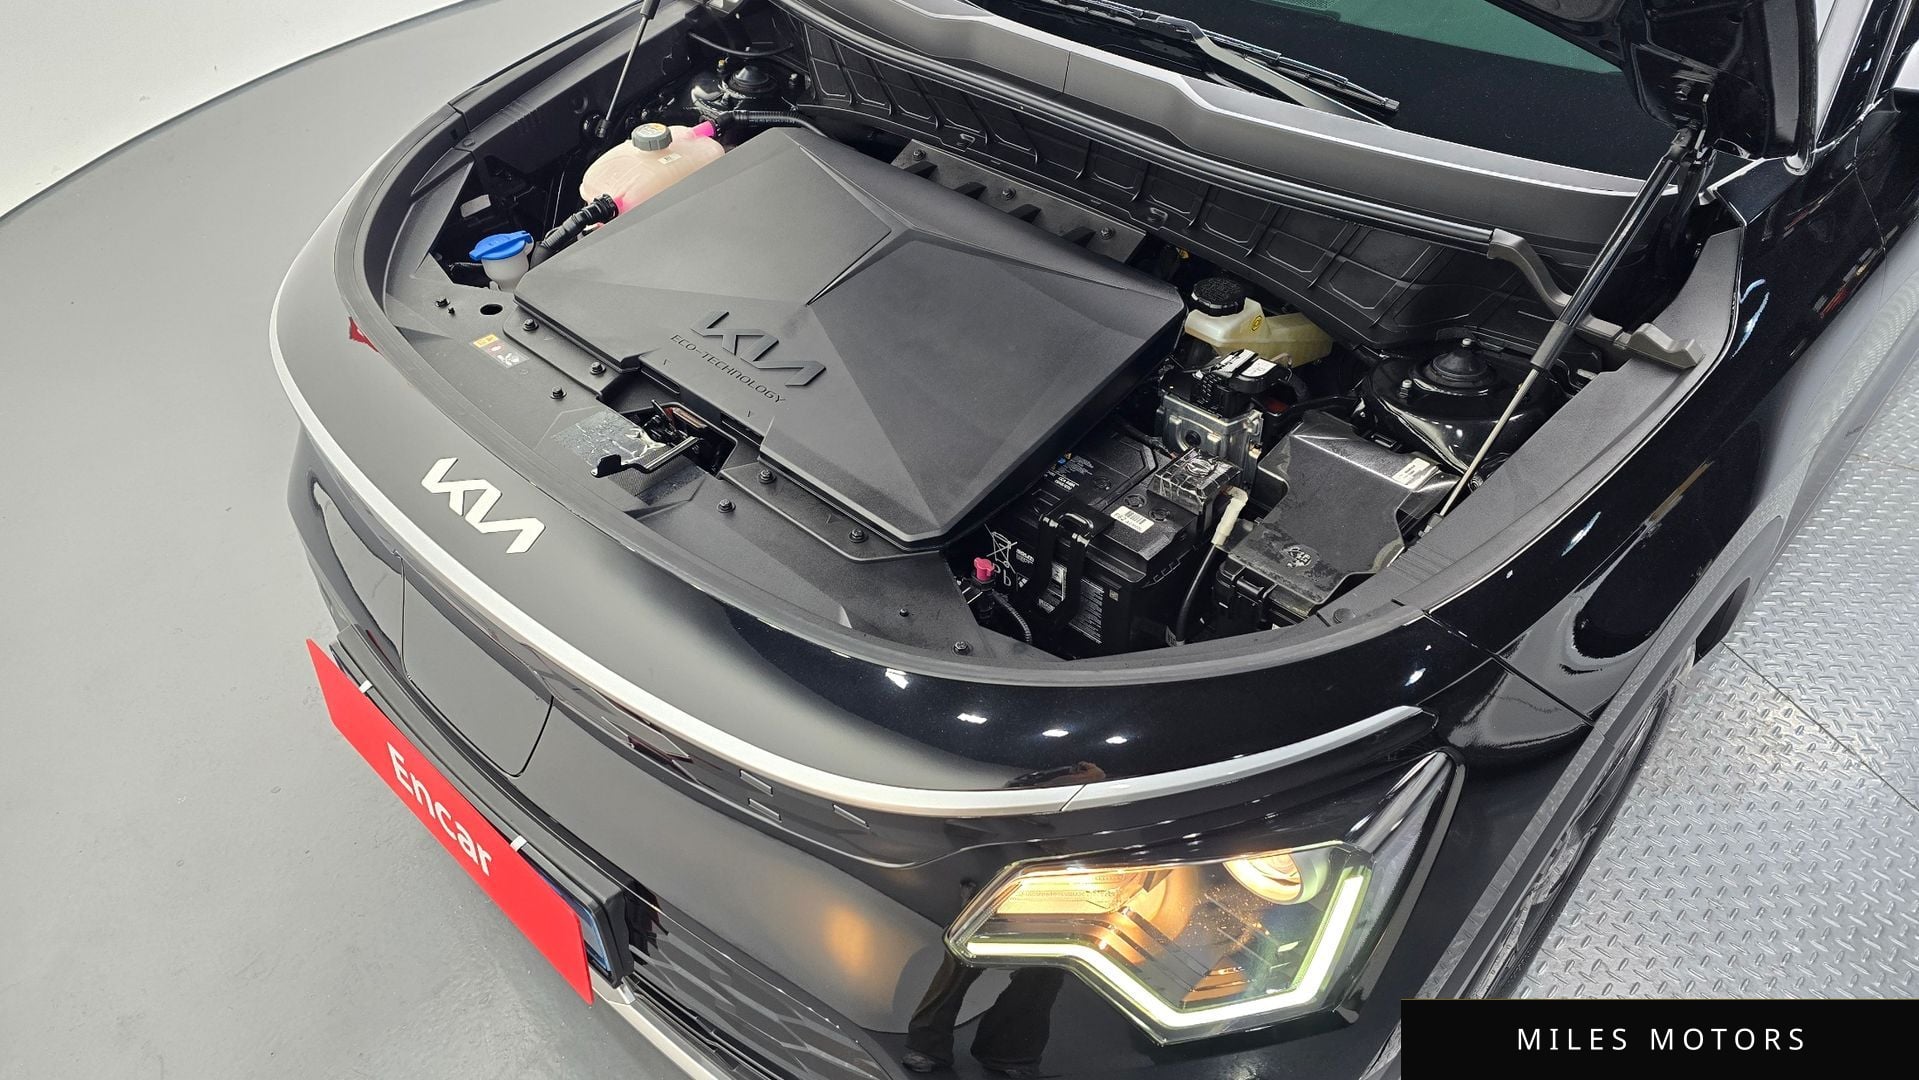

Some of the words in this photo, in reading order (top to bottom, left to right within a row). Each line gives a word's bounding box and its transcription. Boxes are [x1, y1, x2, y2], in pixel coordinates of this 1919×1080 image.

[670, 334, 786, 403] ECO-TECHNOLOGY
[690, 310, 827, 388] KIA
[420, 456, 547, 554] KIA
[386, 741, 493, 877] Encar
